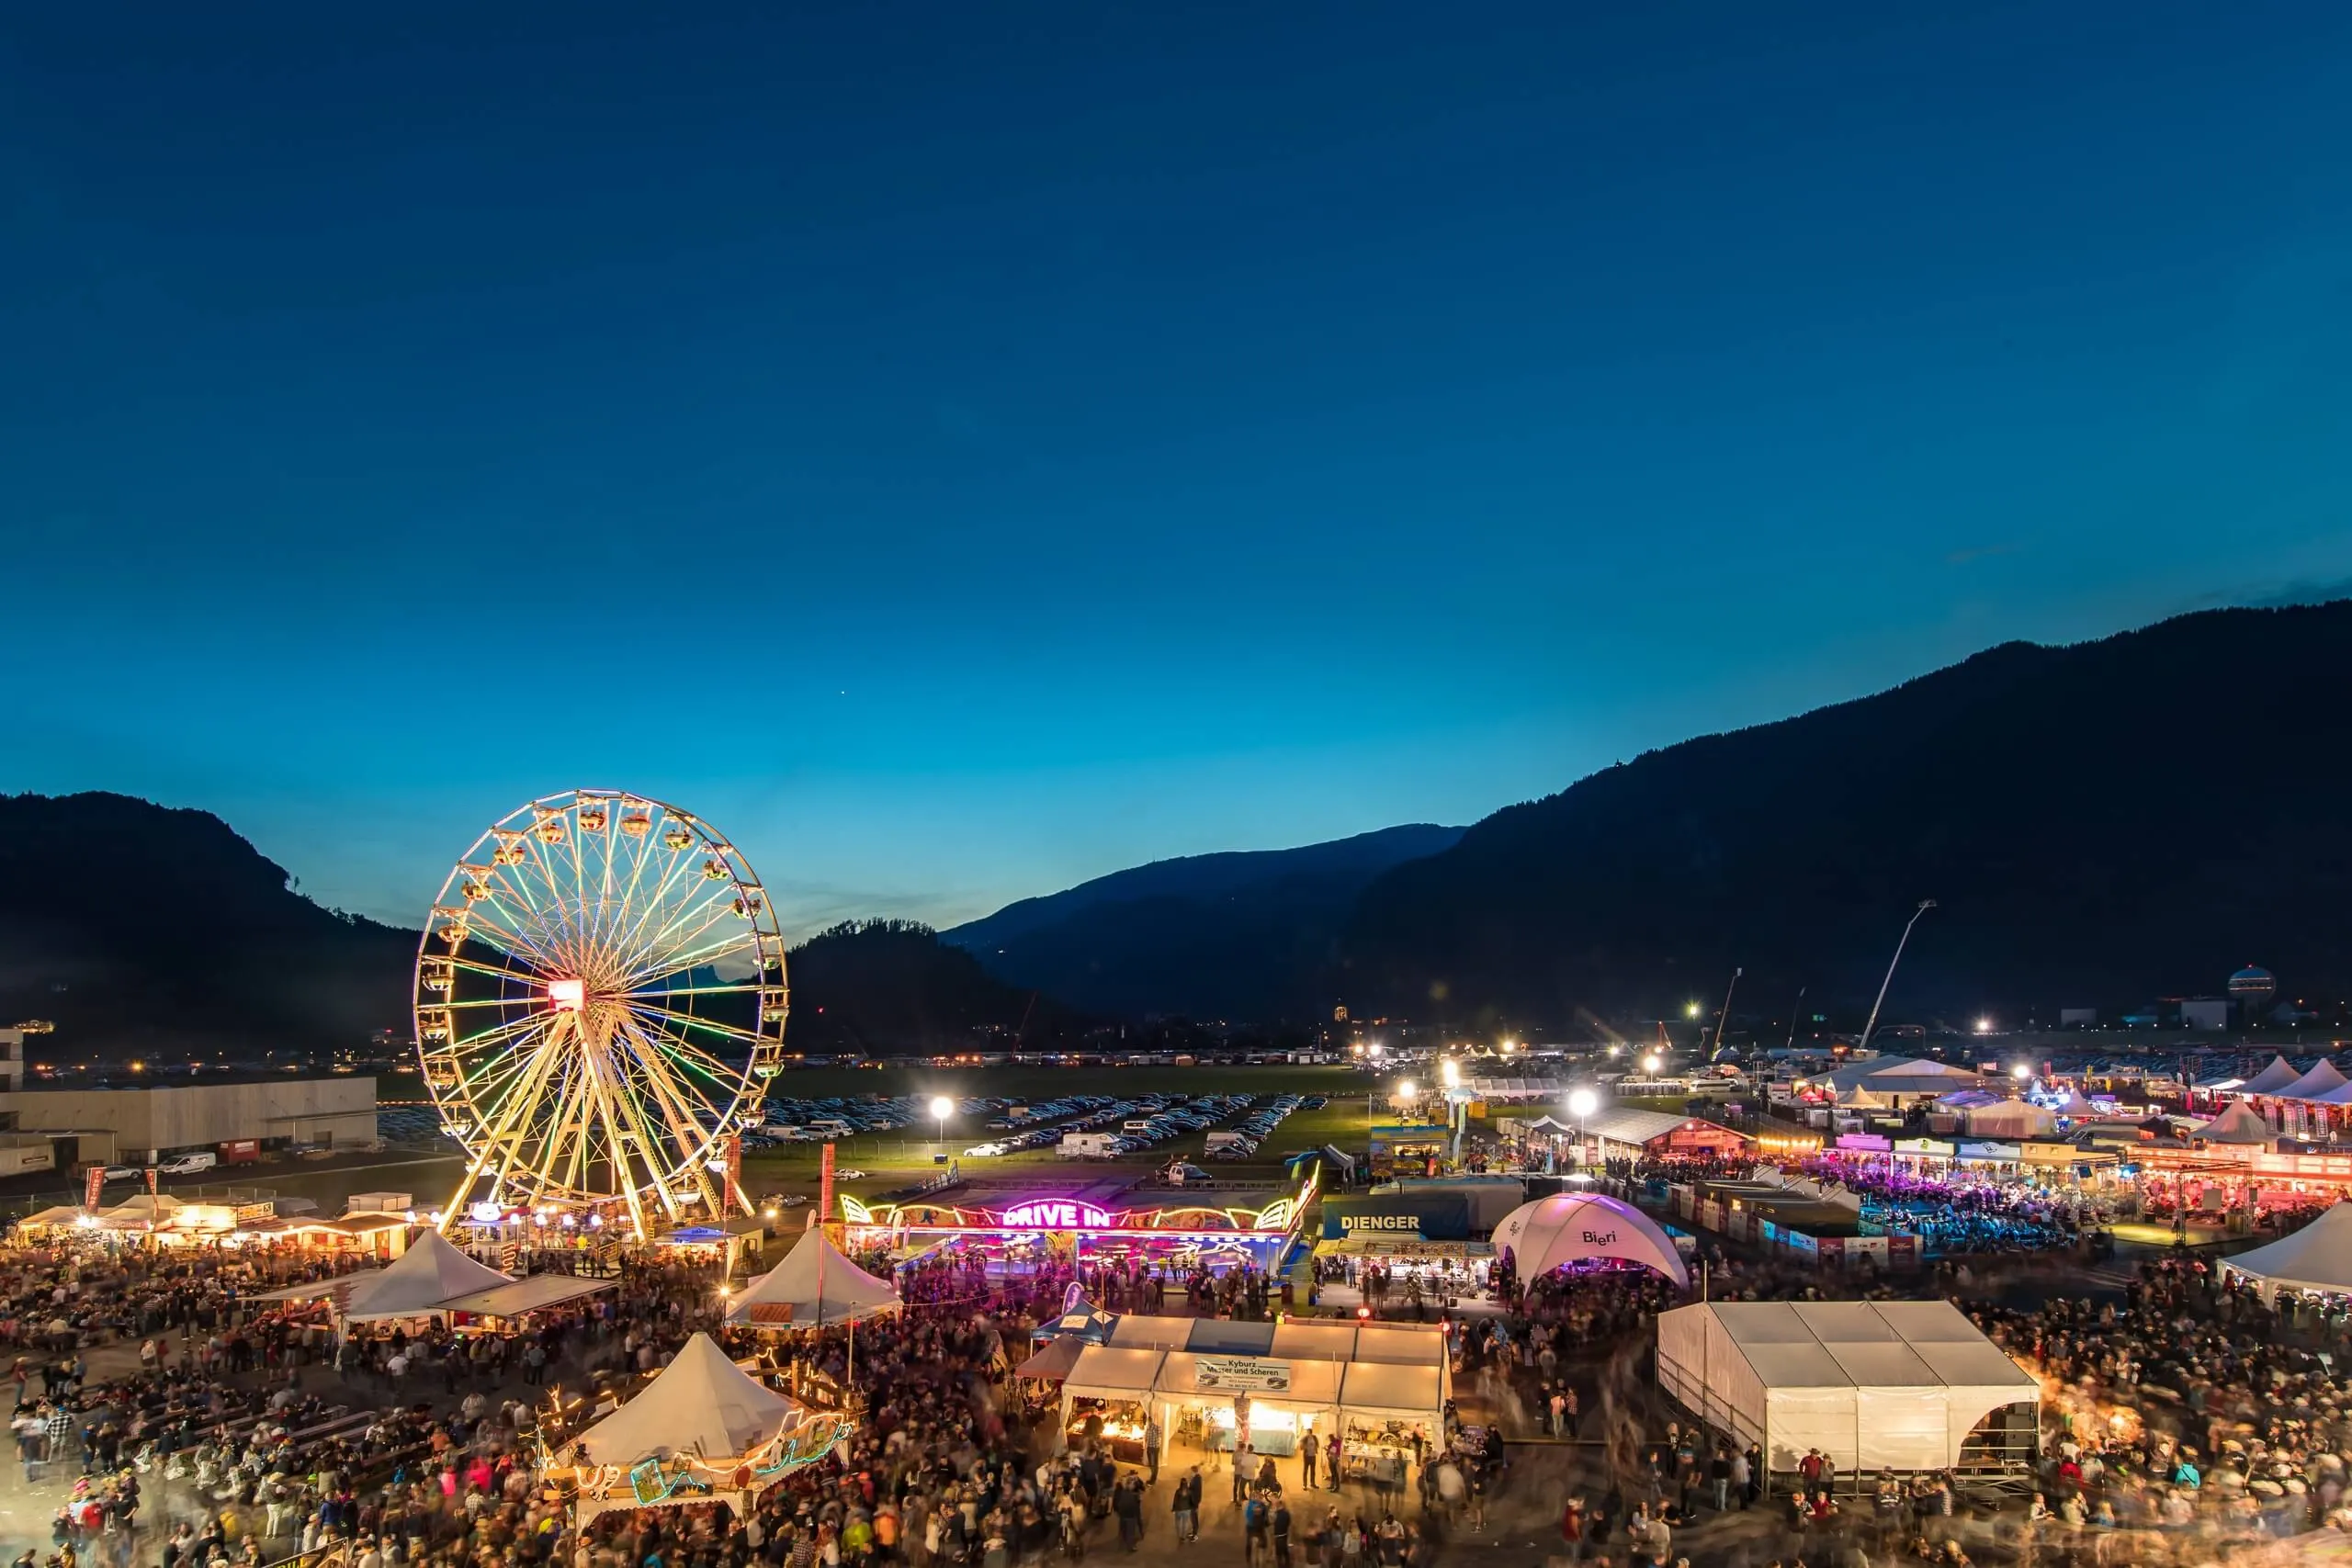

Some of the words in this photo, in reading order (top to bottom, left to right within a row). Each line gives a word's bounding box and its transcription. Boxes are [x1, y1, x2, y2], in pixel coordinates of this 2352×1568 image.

[1002, 1203, 1078, 1226] DRIVE
[1084, 1208, 1110, 1226] IN
[1341, 1215, 1419, 1229] DIENGER
[1582, 1231, 1617, 1247] Bieri
[1228, 1359, 1257, 1368] Kyburz
[1234, 1367, 1249, 1375] und
[1250, 1368, 1279, 1376] Scheren
